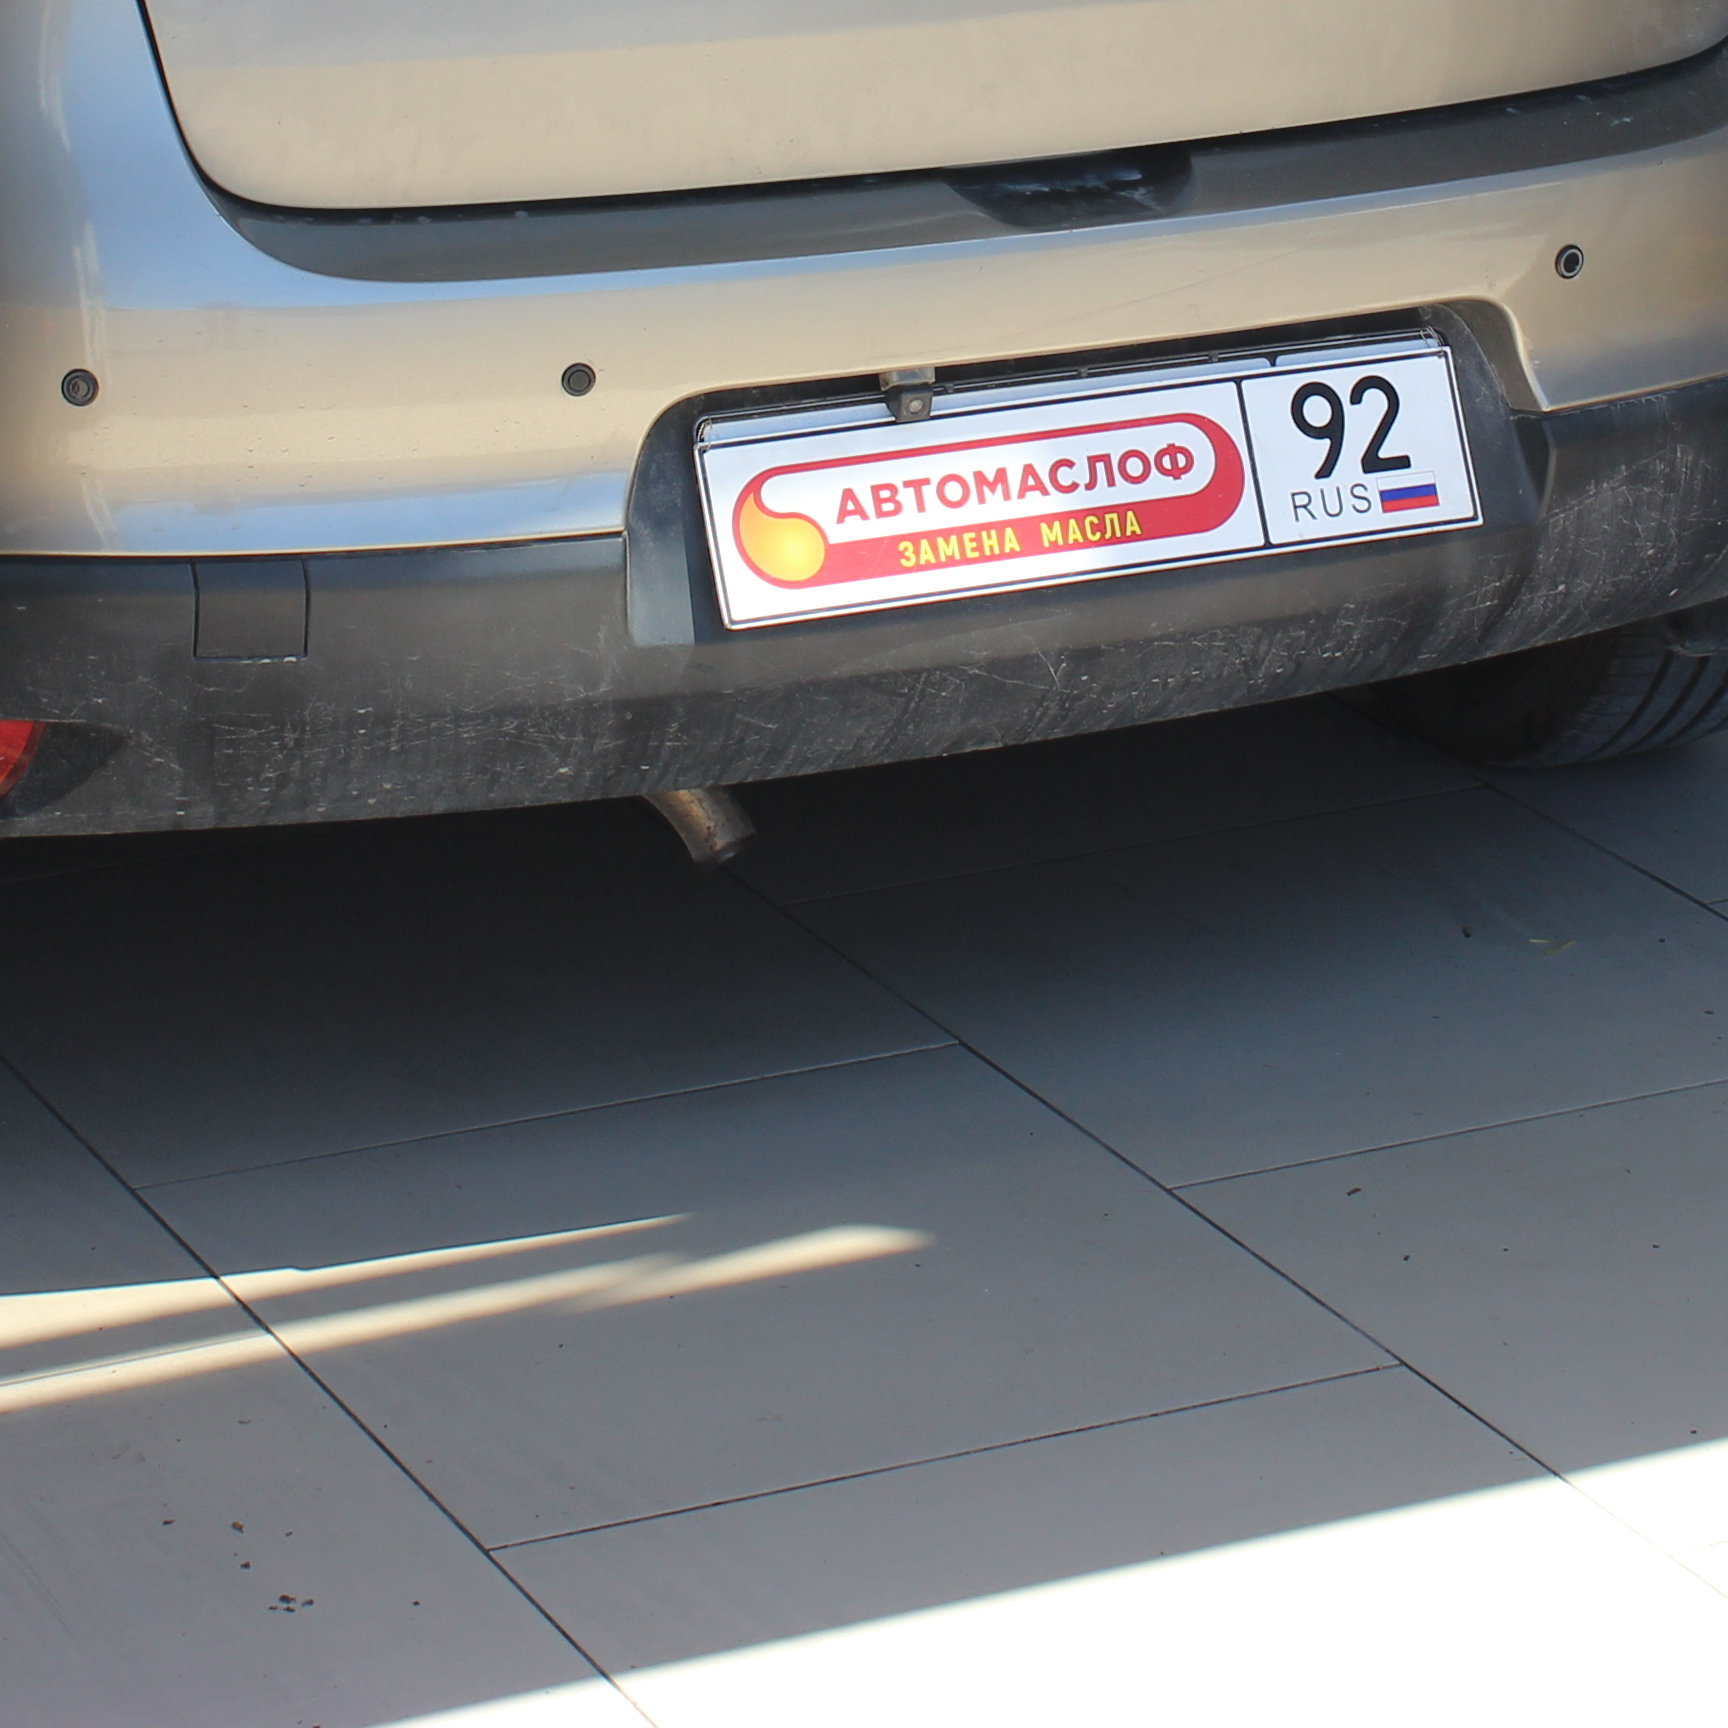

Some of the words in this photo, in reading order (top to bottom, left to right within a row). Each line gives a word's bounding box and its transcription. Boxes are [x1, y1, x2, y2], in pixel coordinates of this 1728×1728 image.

[1291, 374, 1411, 480] 92
[836, 443, 1195, 525] АВТОМАСЛОФ
[1292, 481, 1372, 521] RUS
[898, 527, 1021, 568] ЗАМЕНА
[1041, 509, 1143, 547] МАСЛА
